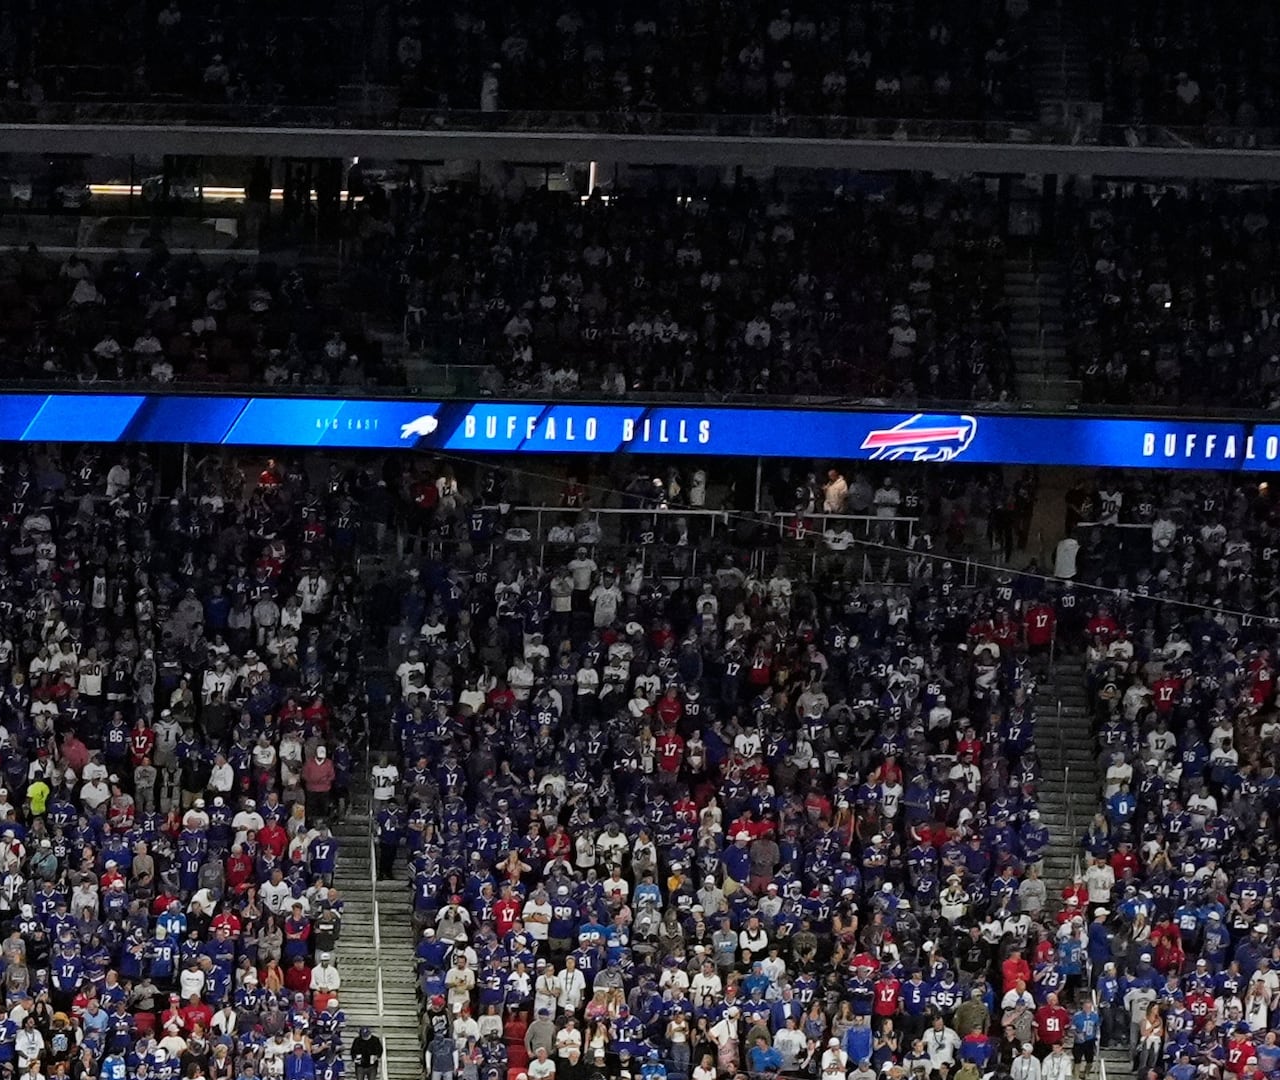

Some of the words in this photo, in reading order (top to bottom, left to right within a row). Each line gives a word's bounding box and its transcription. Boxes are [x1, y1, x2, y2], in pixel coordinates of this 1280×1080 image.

[465, 416, 597, 441] BUFFALO
[622, 418, 711, 443] BILLS
[1143, 433, 1278, 459] BUFFALO
[1160, 686, 1173, 700] 17
[685, 704, 699, 715] 50
[538, 712, 552, 724] 86
[110, 730, 123, 743] 86
[164, 730, 170, 742] 1
[1009, 728, 1021, 740] 17
[135, 736, 147, 748] 17
[588, 742, 600, 754] 17
[665, 743, 677, 756] 17
[316, 846, 330, 858] 17
[187, 861, 198, 872] 10
[154, 949, 171, 961] 78
[62, 965, 74, 977] 17
[881, 987, 894, 1002] 17
[913, 990, 920, 1002] 5
[937, 991, 954, 1005] 95
[1047, 1018, 1059, 1031] 91
[113, 1065, 125, 1079] 58
[325, 1067, 333, 1080] 0
